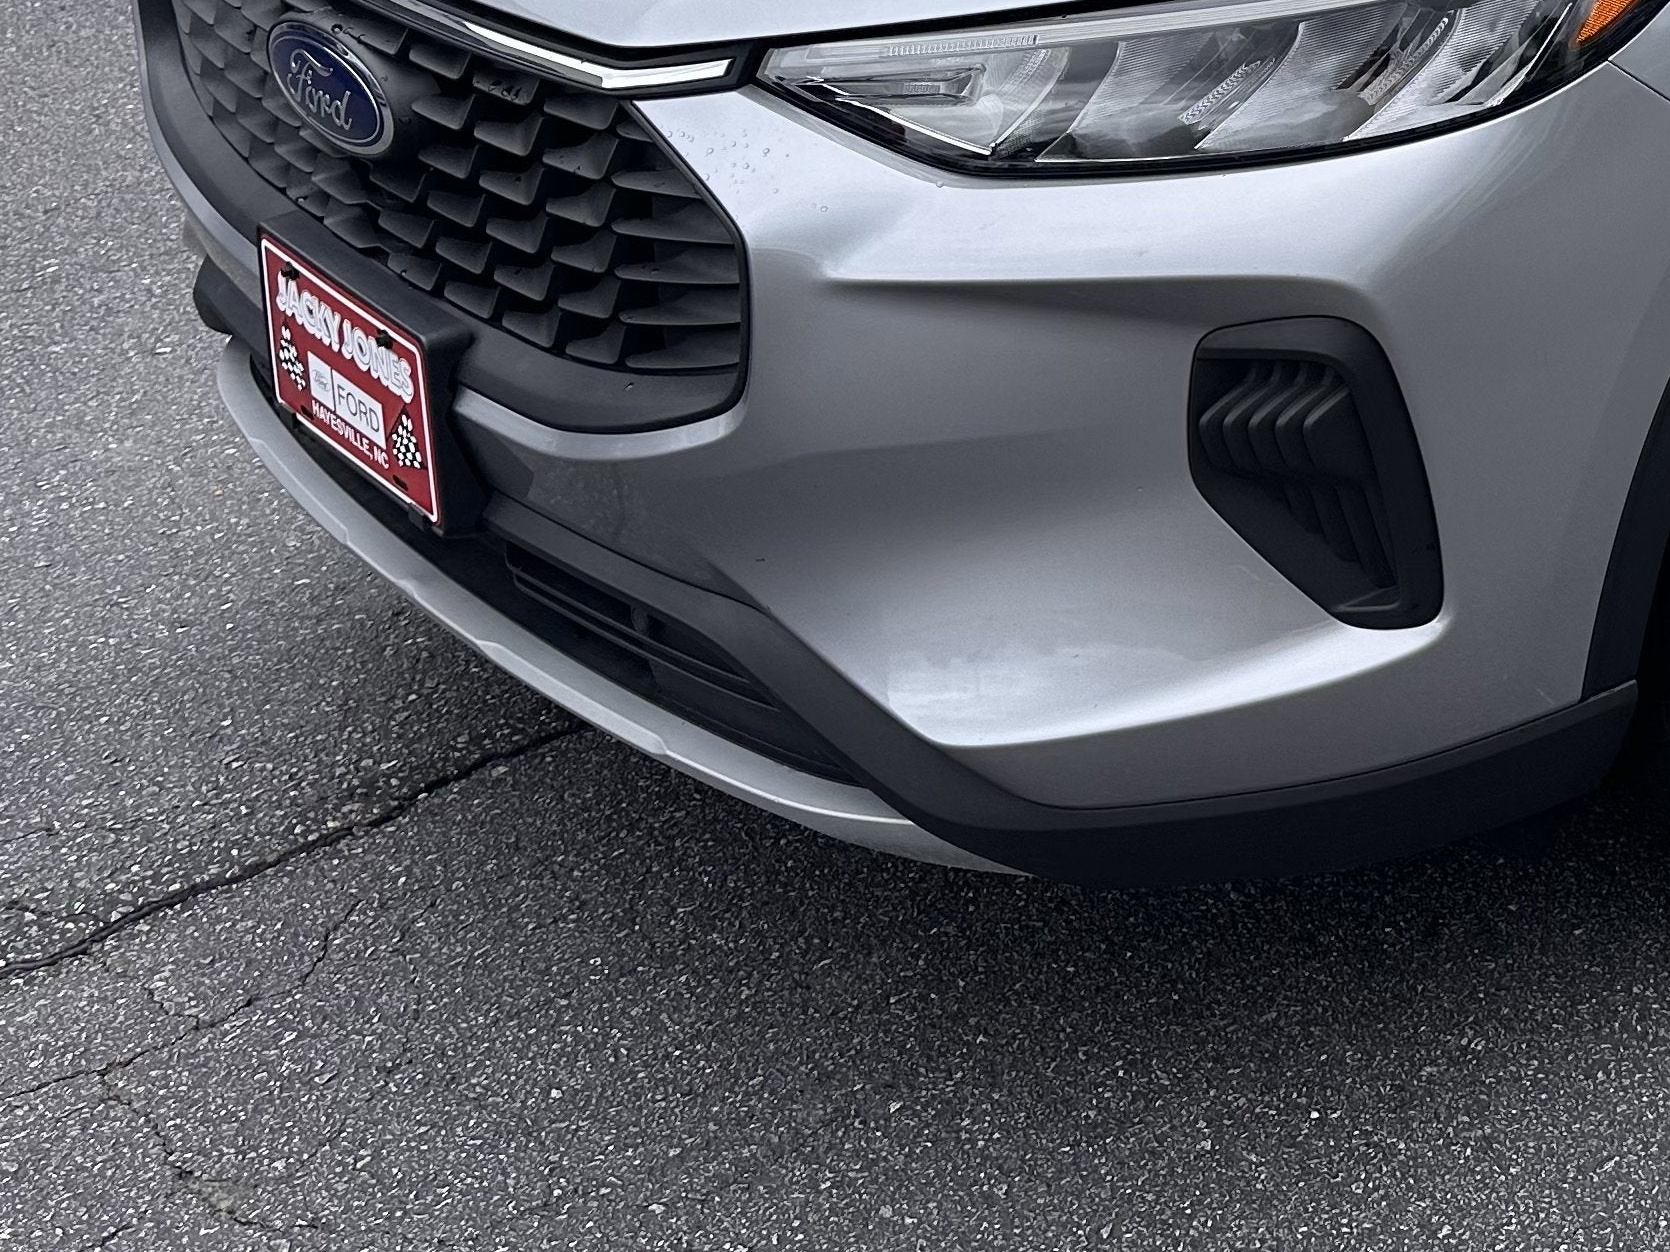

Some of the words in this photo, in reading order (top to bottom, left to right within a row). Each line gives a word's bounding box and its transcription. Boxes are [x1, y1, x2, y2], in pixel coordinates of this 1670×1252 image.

[286, 47, 353, 131] Ford
[276, 270, 341, 353] JACKY
[341, 319, 415, 404] JONES
[311, 399, 373, 461] HAYESVILLE,
[373, 444, 390, 469] NC
[336, 384, 380, 434] FORD
